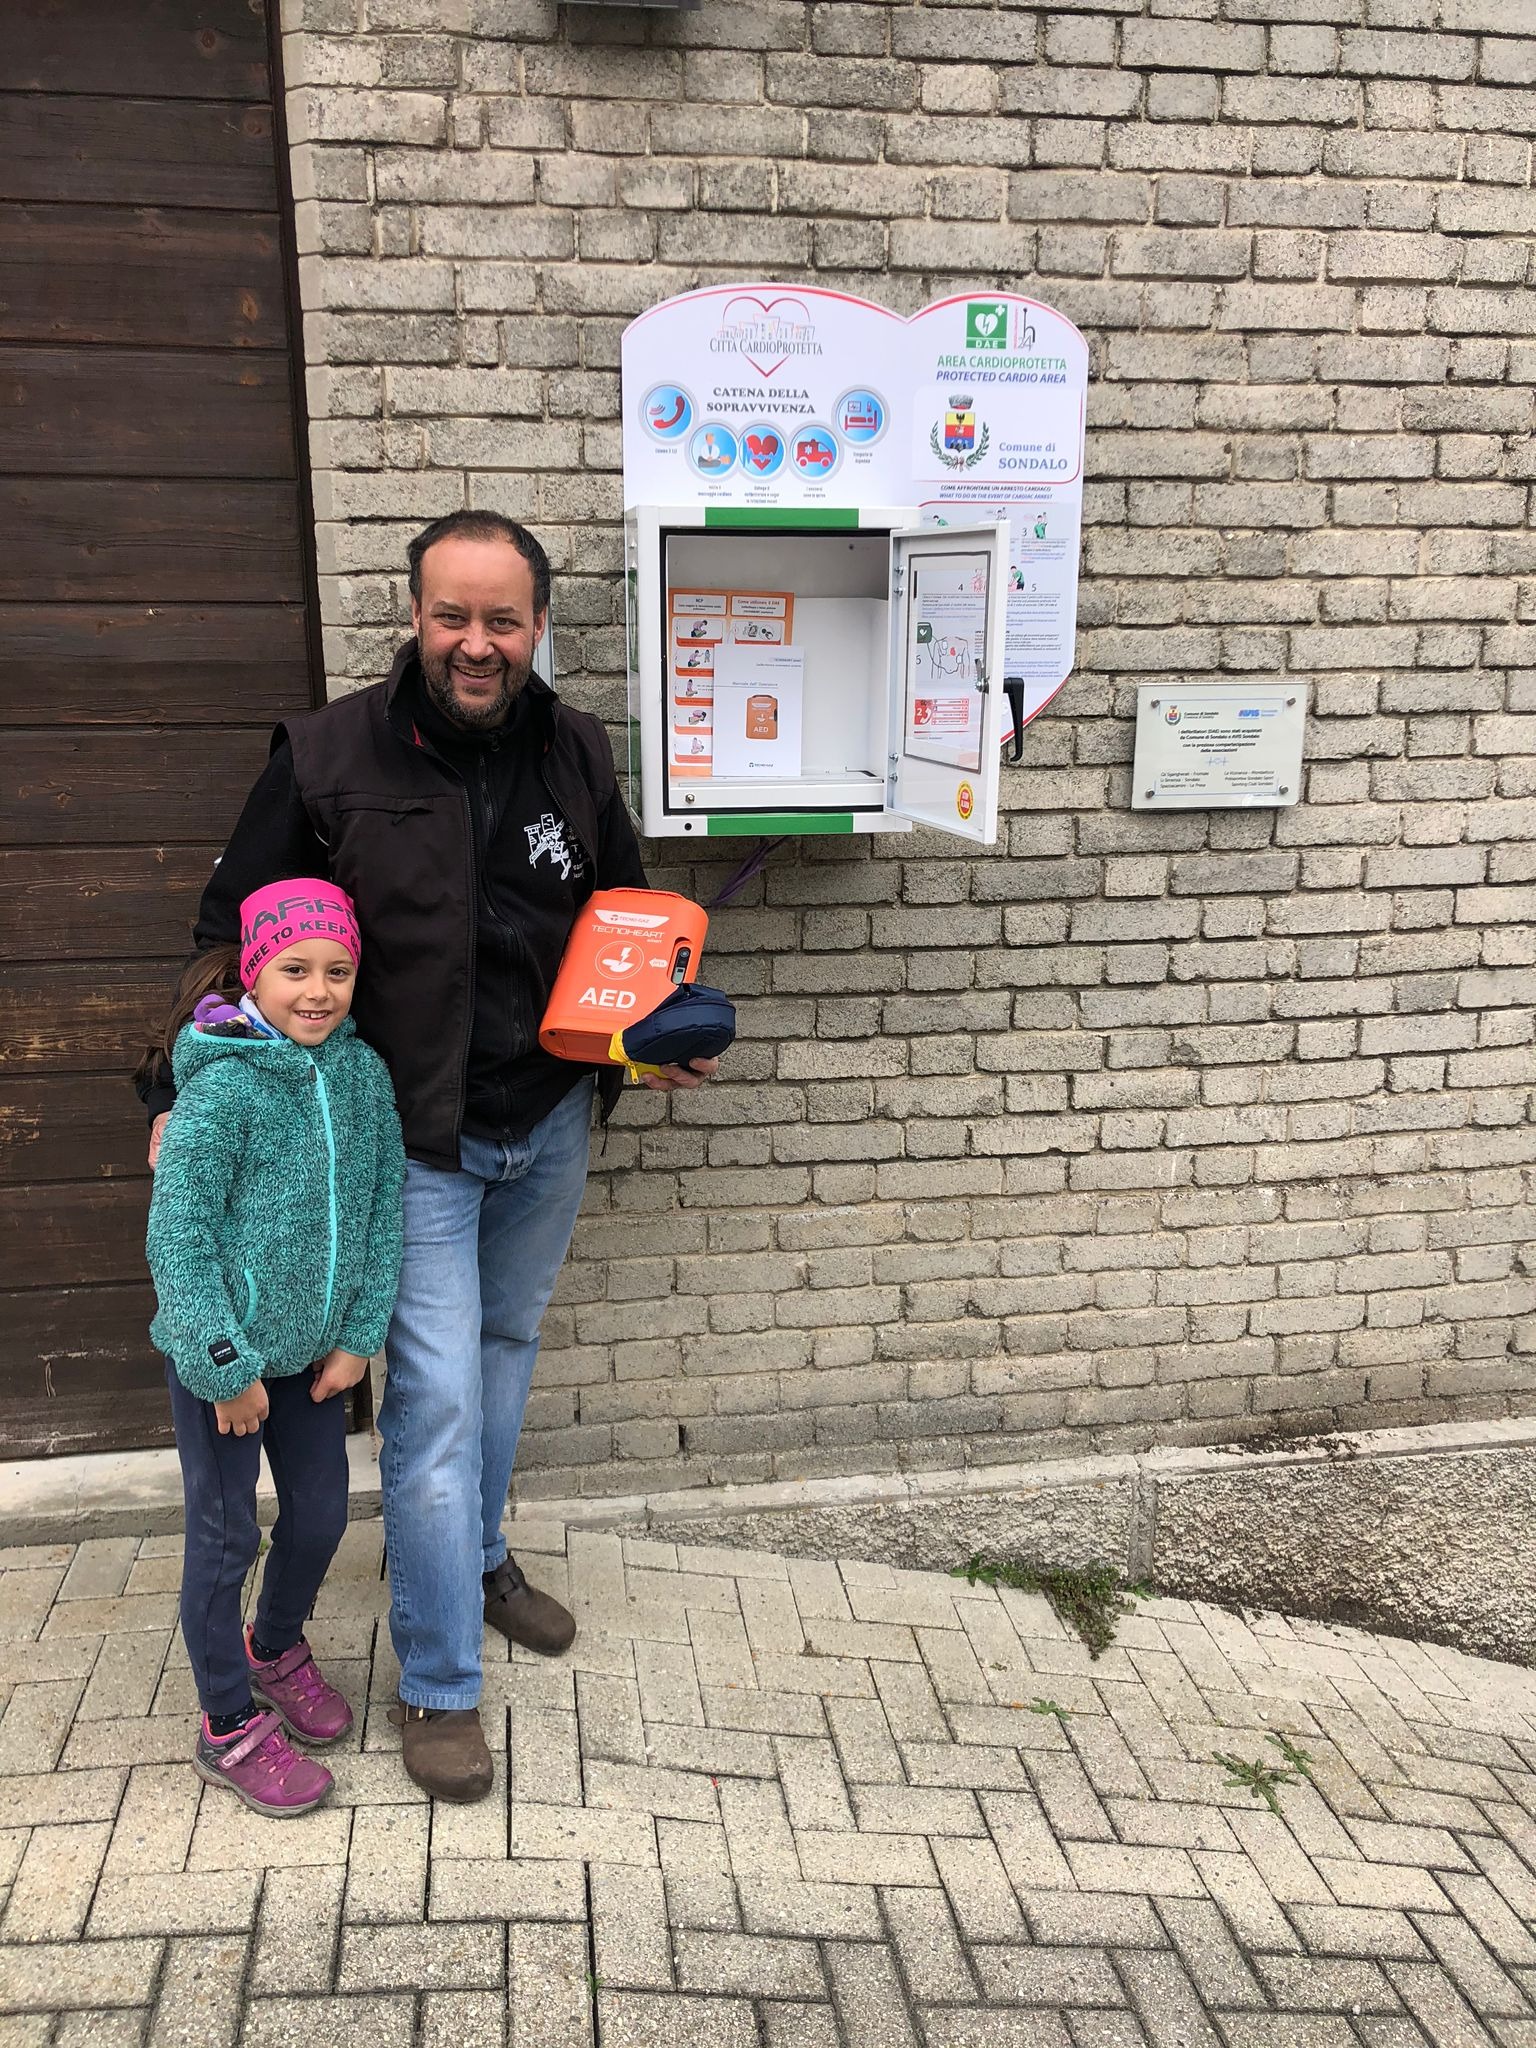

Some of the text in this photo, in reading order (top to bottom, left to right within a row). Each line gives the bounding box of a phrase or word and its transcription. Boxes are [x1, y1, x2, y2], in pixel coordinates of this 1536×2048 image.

[975, 340, 999, 349] DAE
[937, 355, 1067, 370] AREA CARDIOPROTETTA
[936, 370, 1067, 384] PROTECTED CARDIO AREA
[713, 387, 810, 399] CATENA DELLA
[706, 402, 816, 414] SOPRAVVIVENZA
[999, 442, 1056, 452] Comune di
[998, 458, 1068, 470] SONDALO
[1021, 528, 1028, 536] 3
[958, 583, 964, 592] 4
[1032, 584, 1037, 592] 5
[916, 655, 922, 664] 5
[1238, 709, 1260, 717] AVIS
[592, 925, 665, 938] TECNOHEART
[245, 943, 270, 978] FREE
[271, 926, 293, 944] TO
[299, 920, 347, 935] KEEP
[578, 987, 637, 1009] AED
